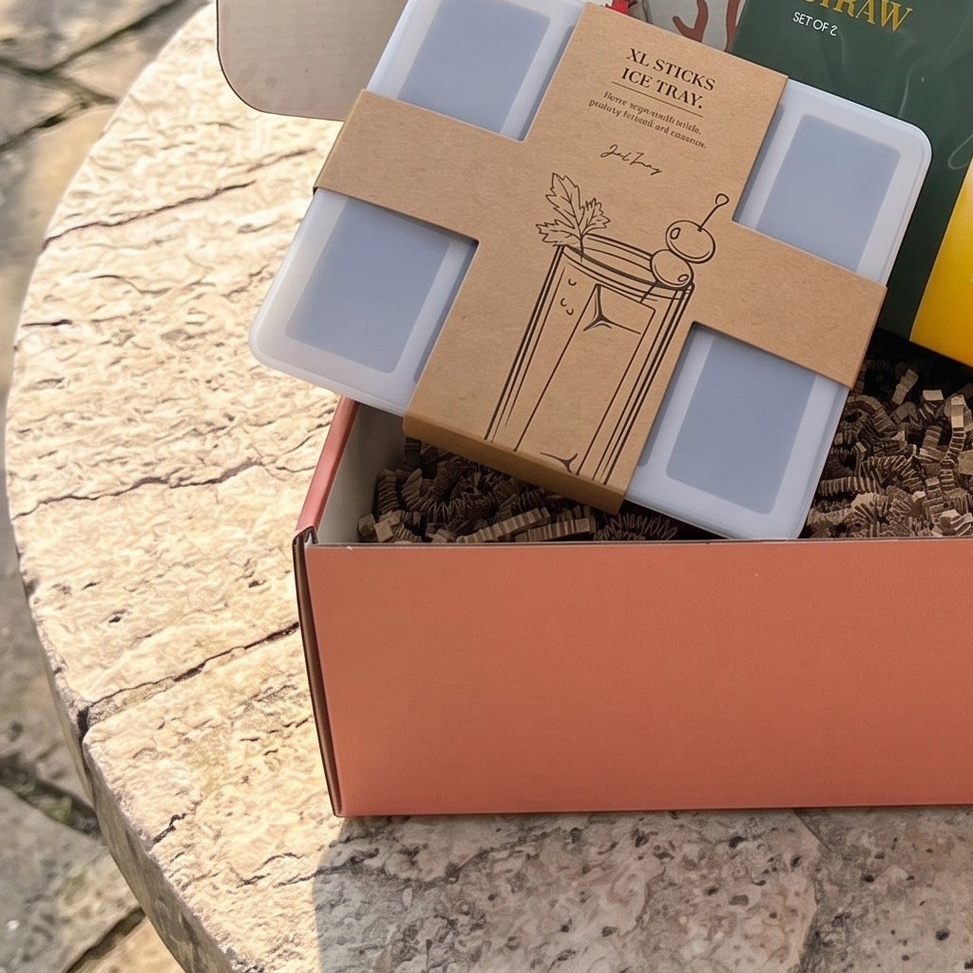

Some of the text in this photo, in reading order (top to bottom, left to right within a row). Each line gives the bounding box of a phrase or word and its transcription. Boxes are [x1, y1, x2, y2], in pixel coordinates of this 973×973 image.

[793, 11, 813, 26] SET
[813, 19, 829, 32] OF
[621, 67, 703, 109] ICE TRAY.
[626, 48, 716, 91] XL STICKS
